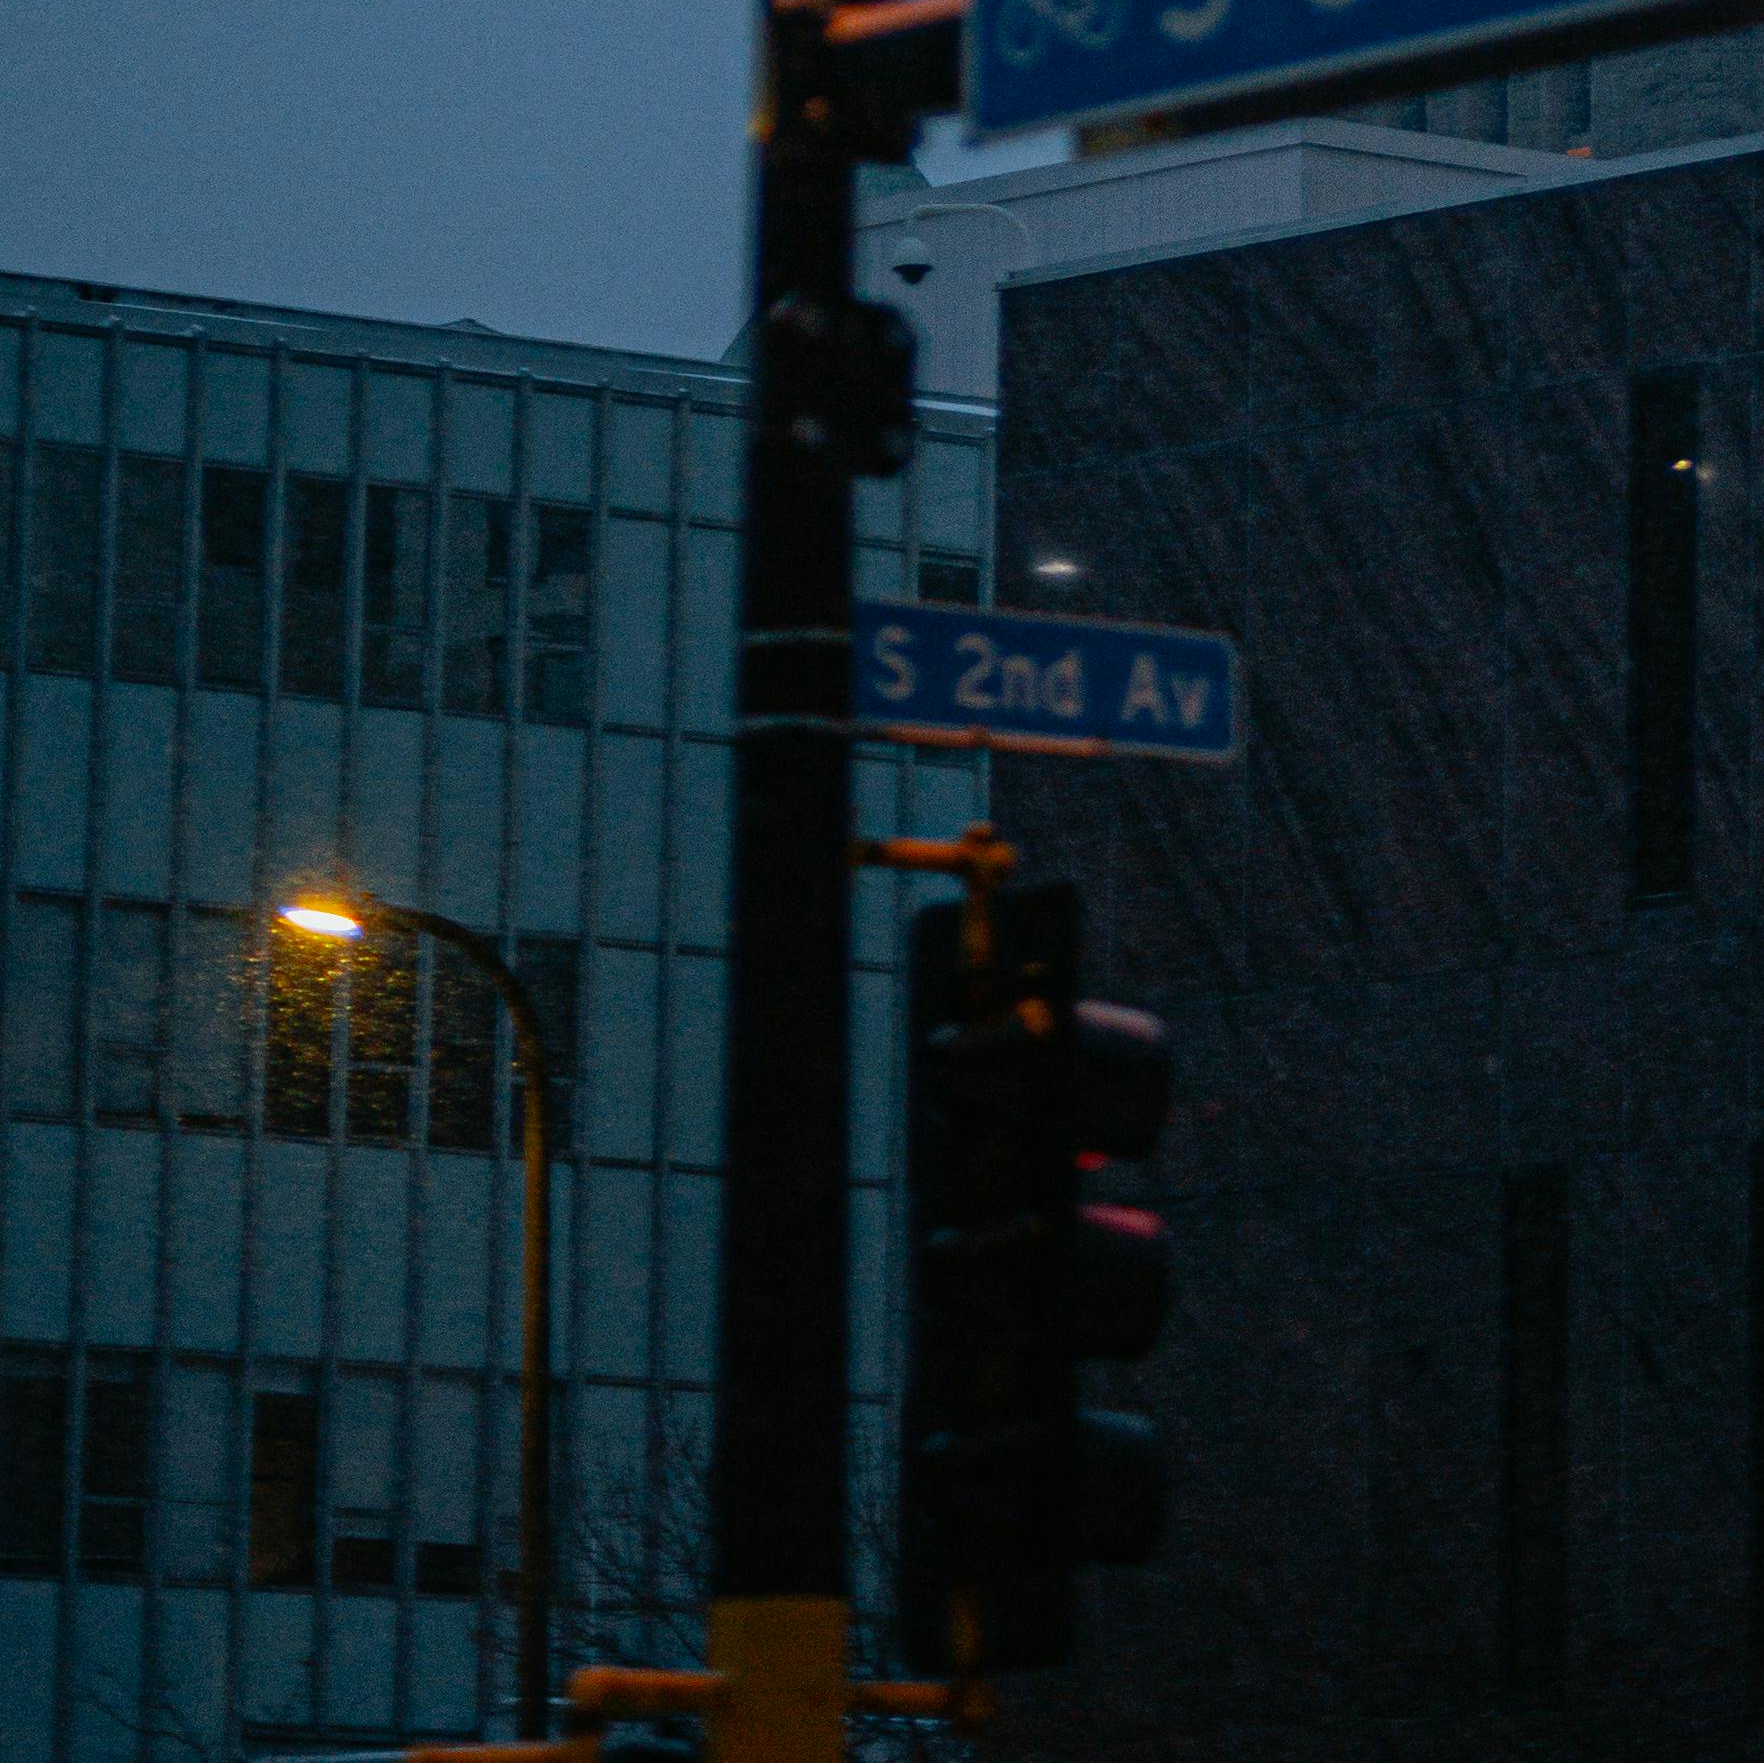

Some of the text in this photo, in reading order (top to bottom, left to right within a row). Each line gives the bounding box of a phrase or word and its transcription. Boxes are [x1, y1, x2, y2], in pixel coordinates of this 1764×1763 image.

[872, 624, 1209, 729] S 2nd Av
